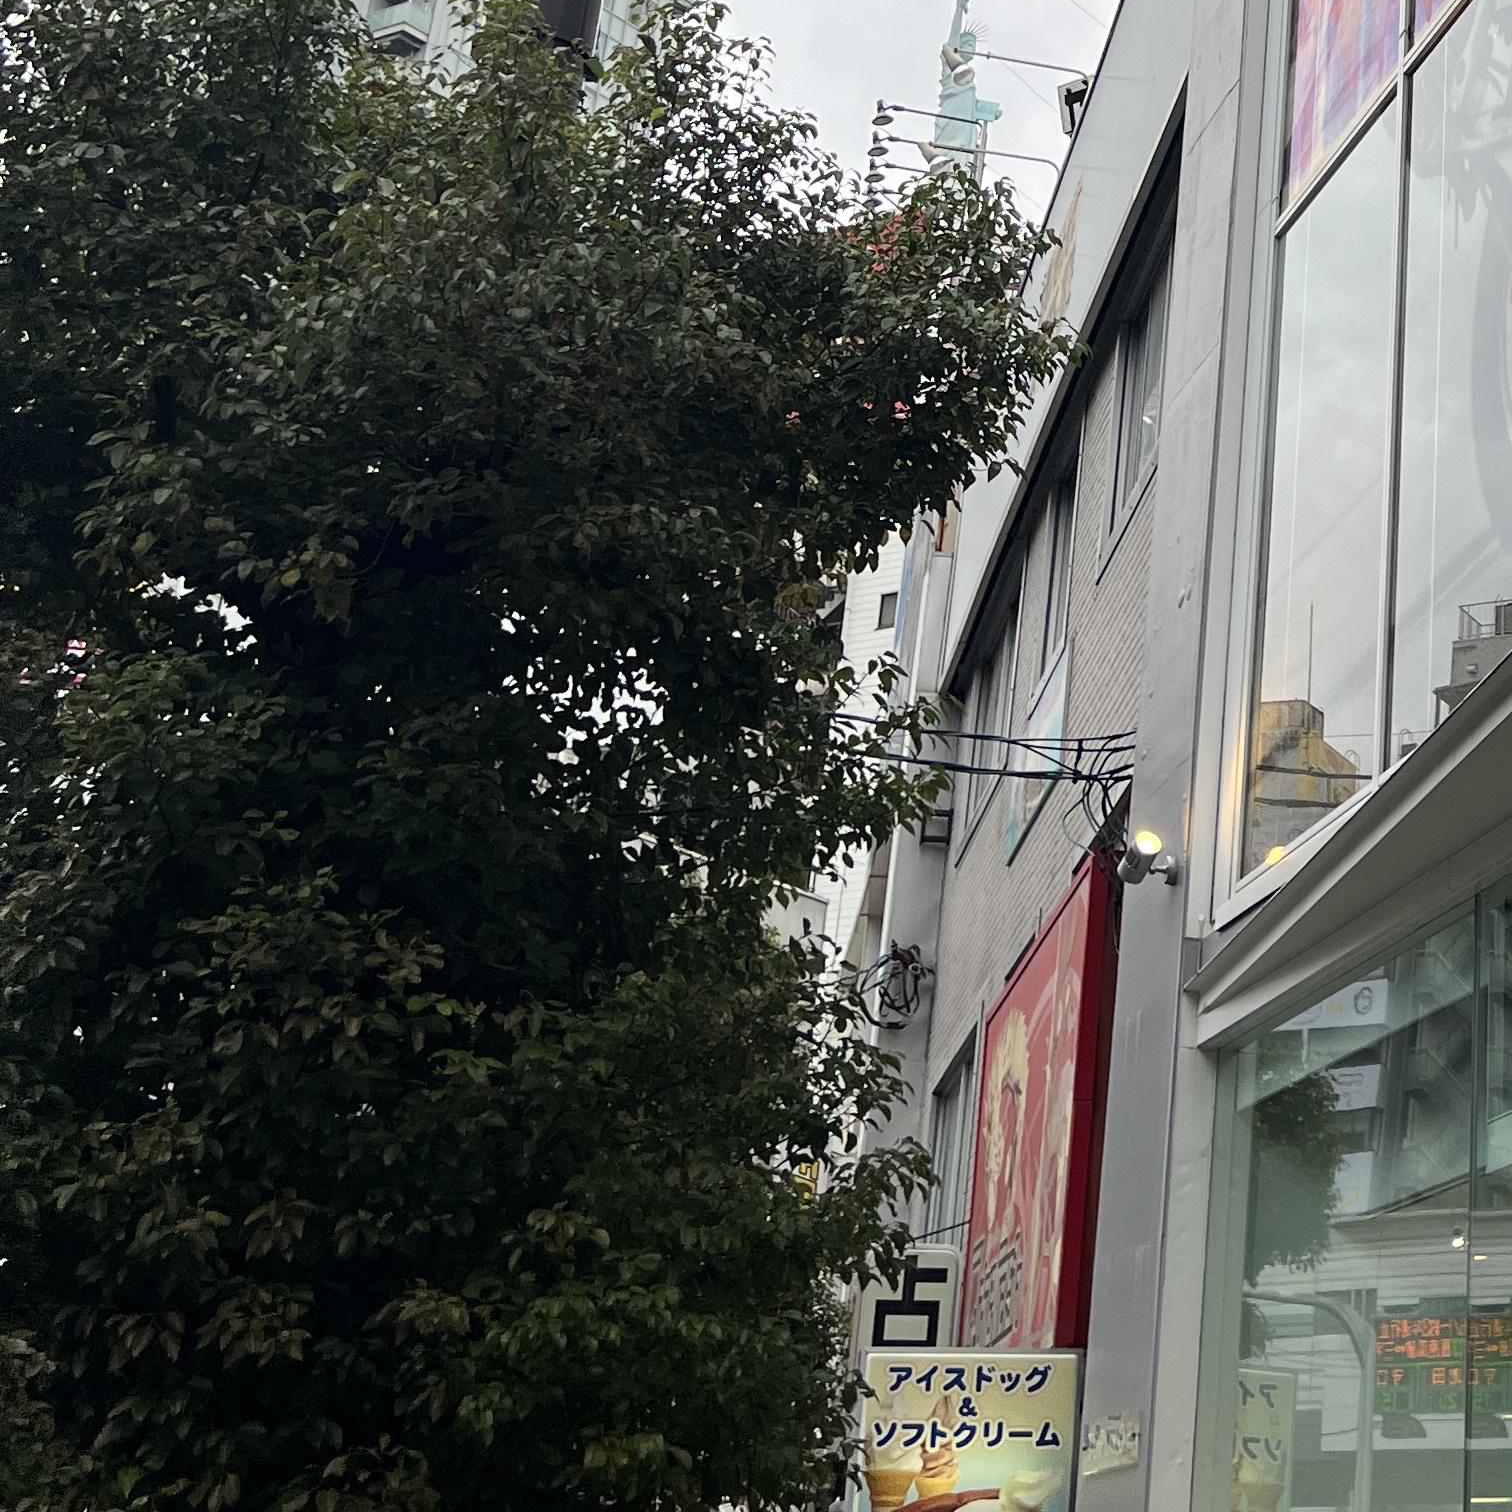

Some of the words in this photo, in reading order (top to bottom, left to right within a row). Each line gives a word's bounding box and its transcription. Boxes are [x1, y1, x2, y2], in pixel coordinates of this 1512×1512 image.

[888, 1365, 1051, 1393] アイスドッグ
[958, 1397, 978, 1418] &
[873, 1422, 1061, 1449] ソフトクリーム
